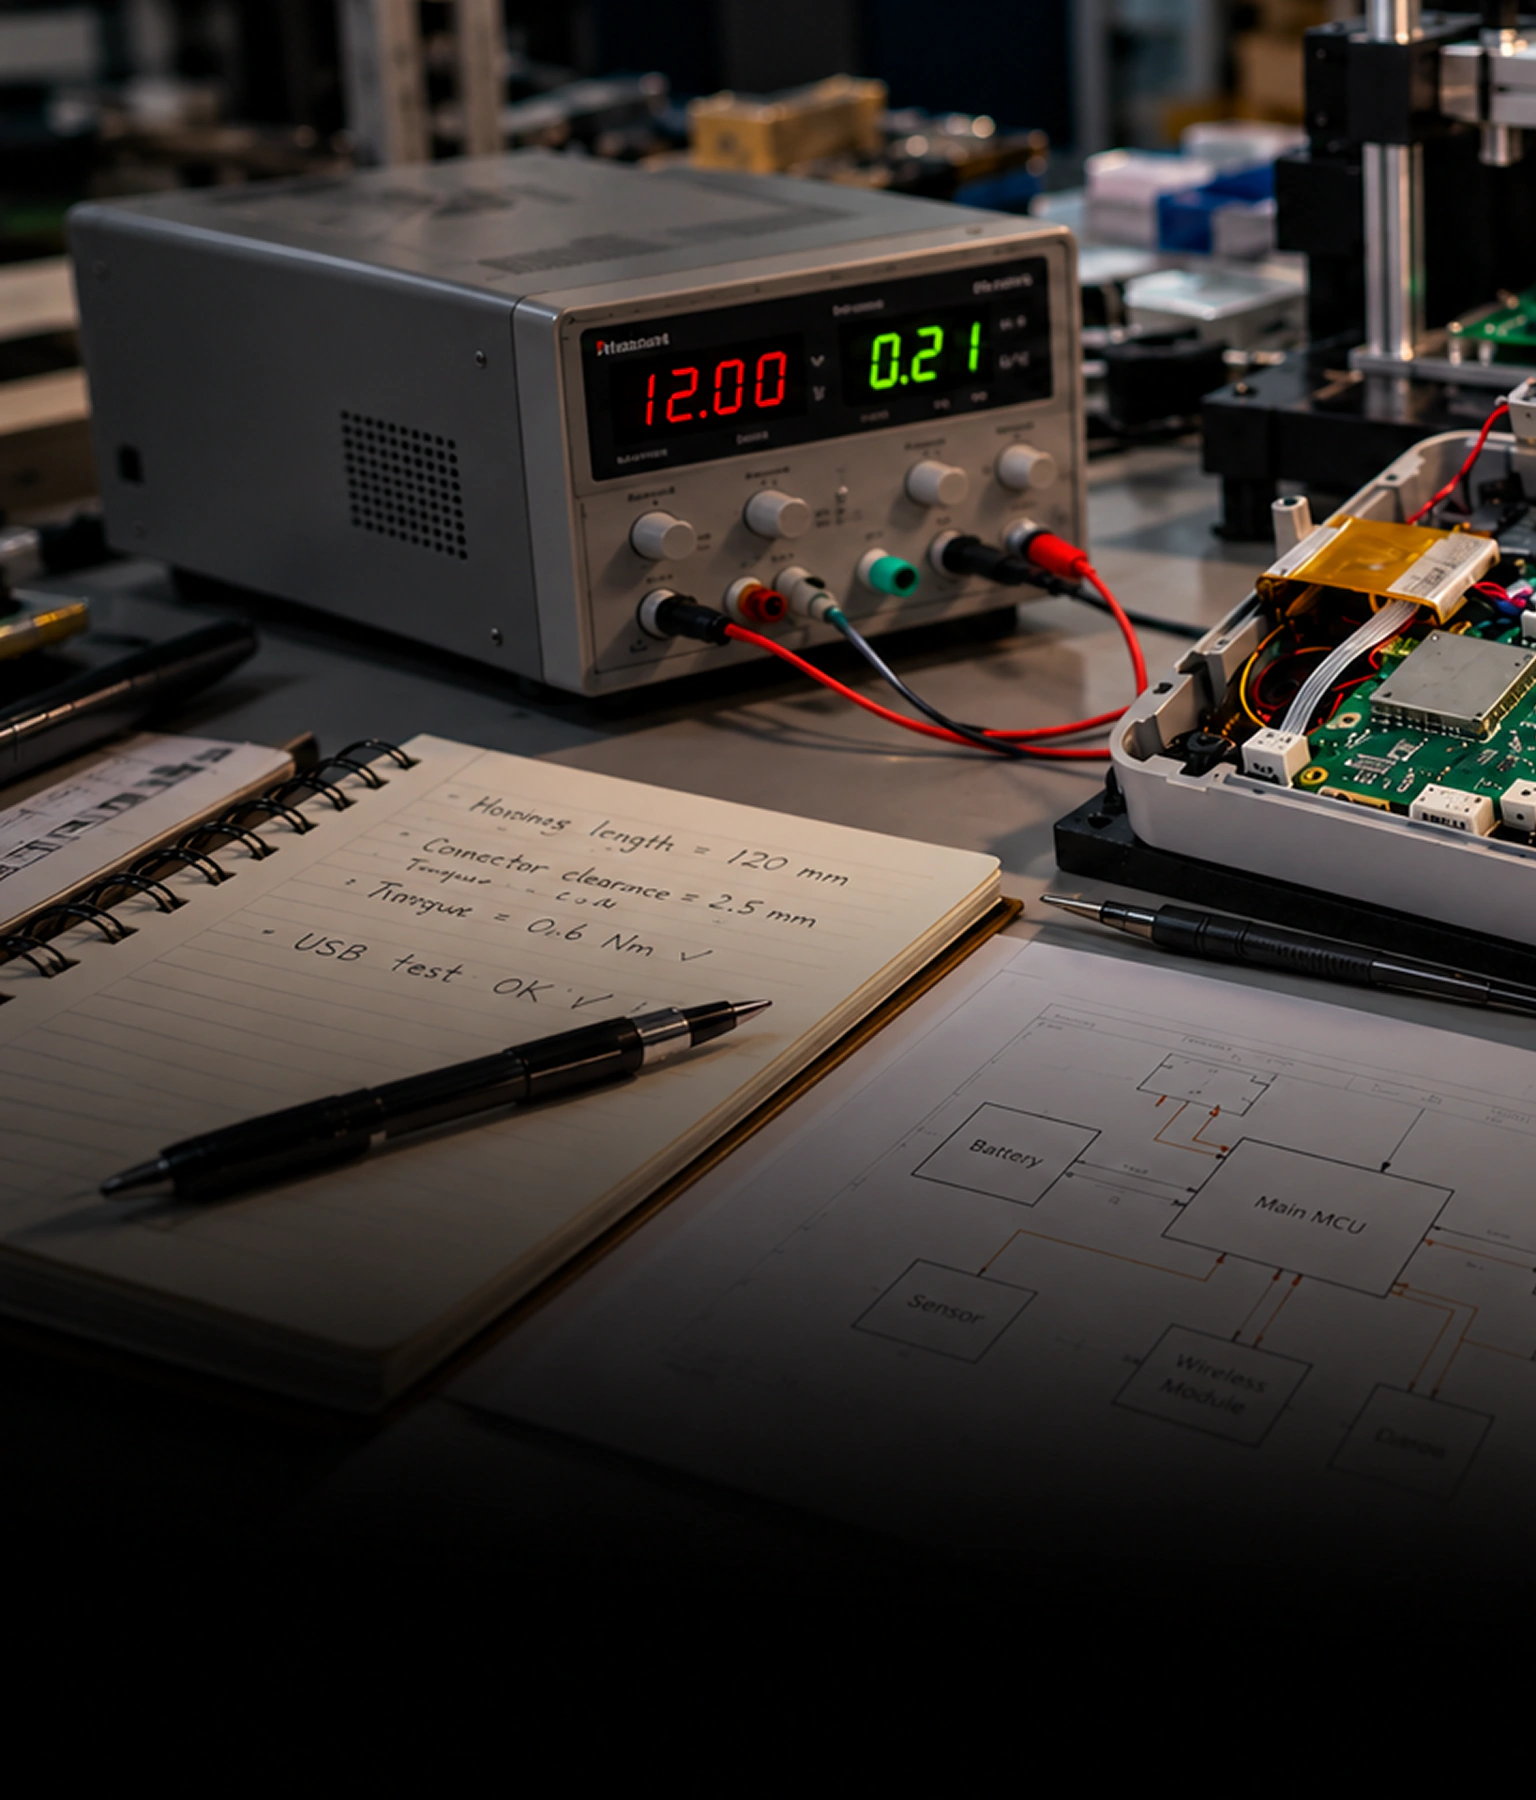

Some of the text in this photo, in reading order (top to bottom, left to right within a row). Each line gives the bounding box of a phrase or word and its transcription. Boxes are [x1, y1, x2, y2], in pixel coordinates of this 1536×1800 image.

[868, 321, 982, 391] 0.21
[644, 350, 788, 427] 12.00
[589, 820, 675, 853] length
[727, 849, 789, 871] 120
[796, 867, 849, 887] mm
[708, 894, 765, 915] 2.5
[766, 909, 817, 929] mm
[600, 932, 655, 958] Nm
[293, 932, 555, 1003] USB test OK
[969, 1138, 1044, 1170] Battery
[1253, 1194, 1367, 1236] Main MCU
[907, 1293, 987, 1328] Sensor
[1175, 1353, 1269, 1395] Wireless
[1158, 1378, 1246, 1416] Module
